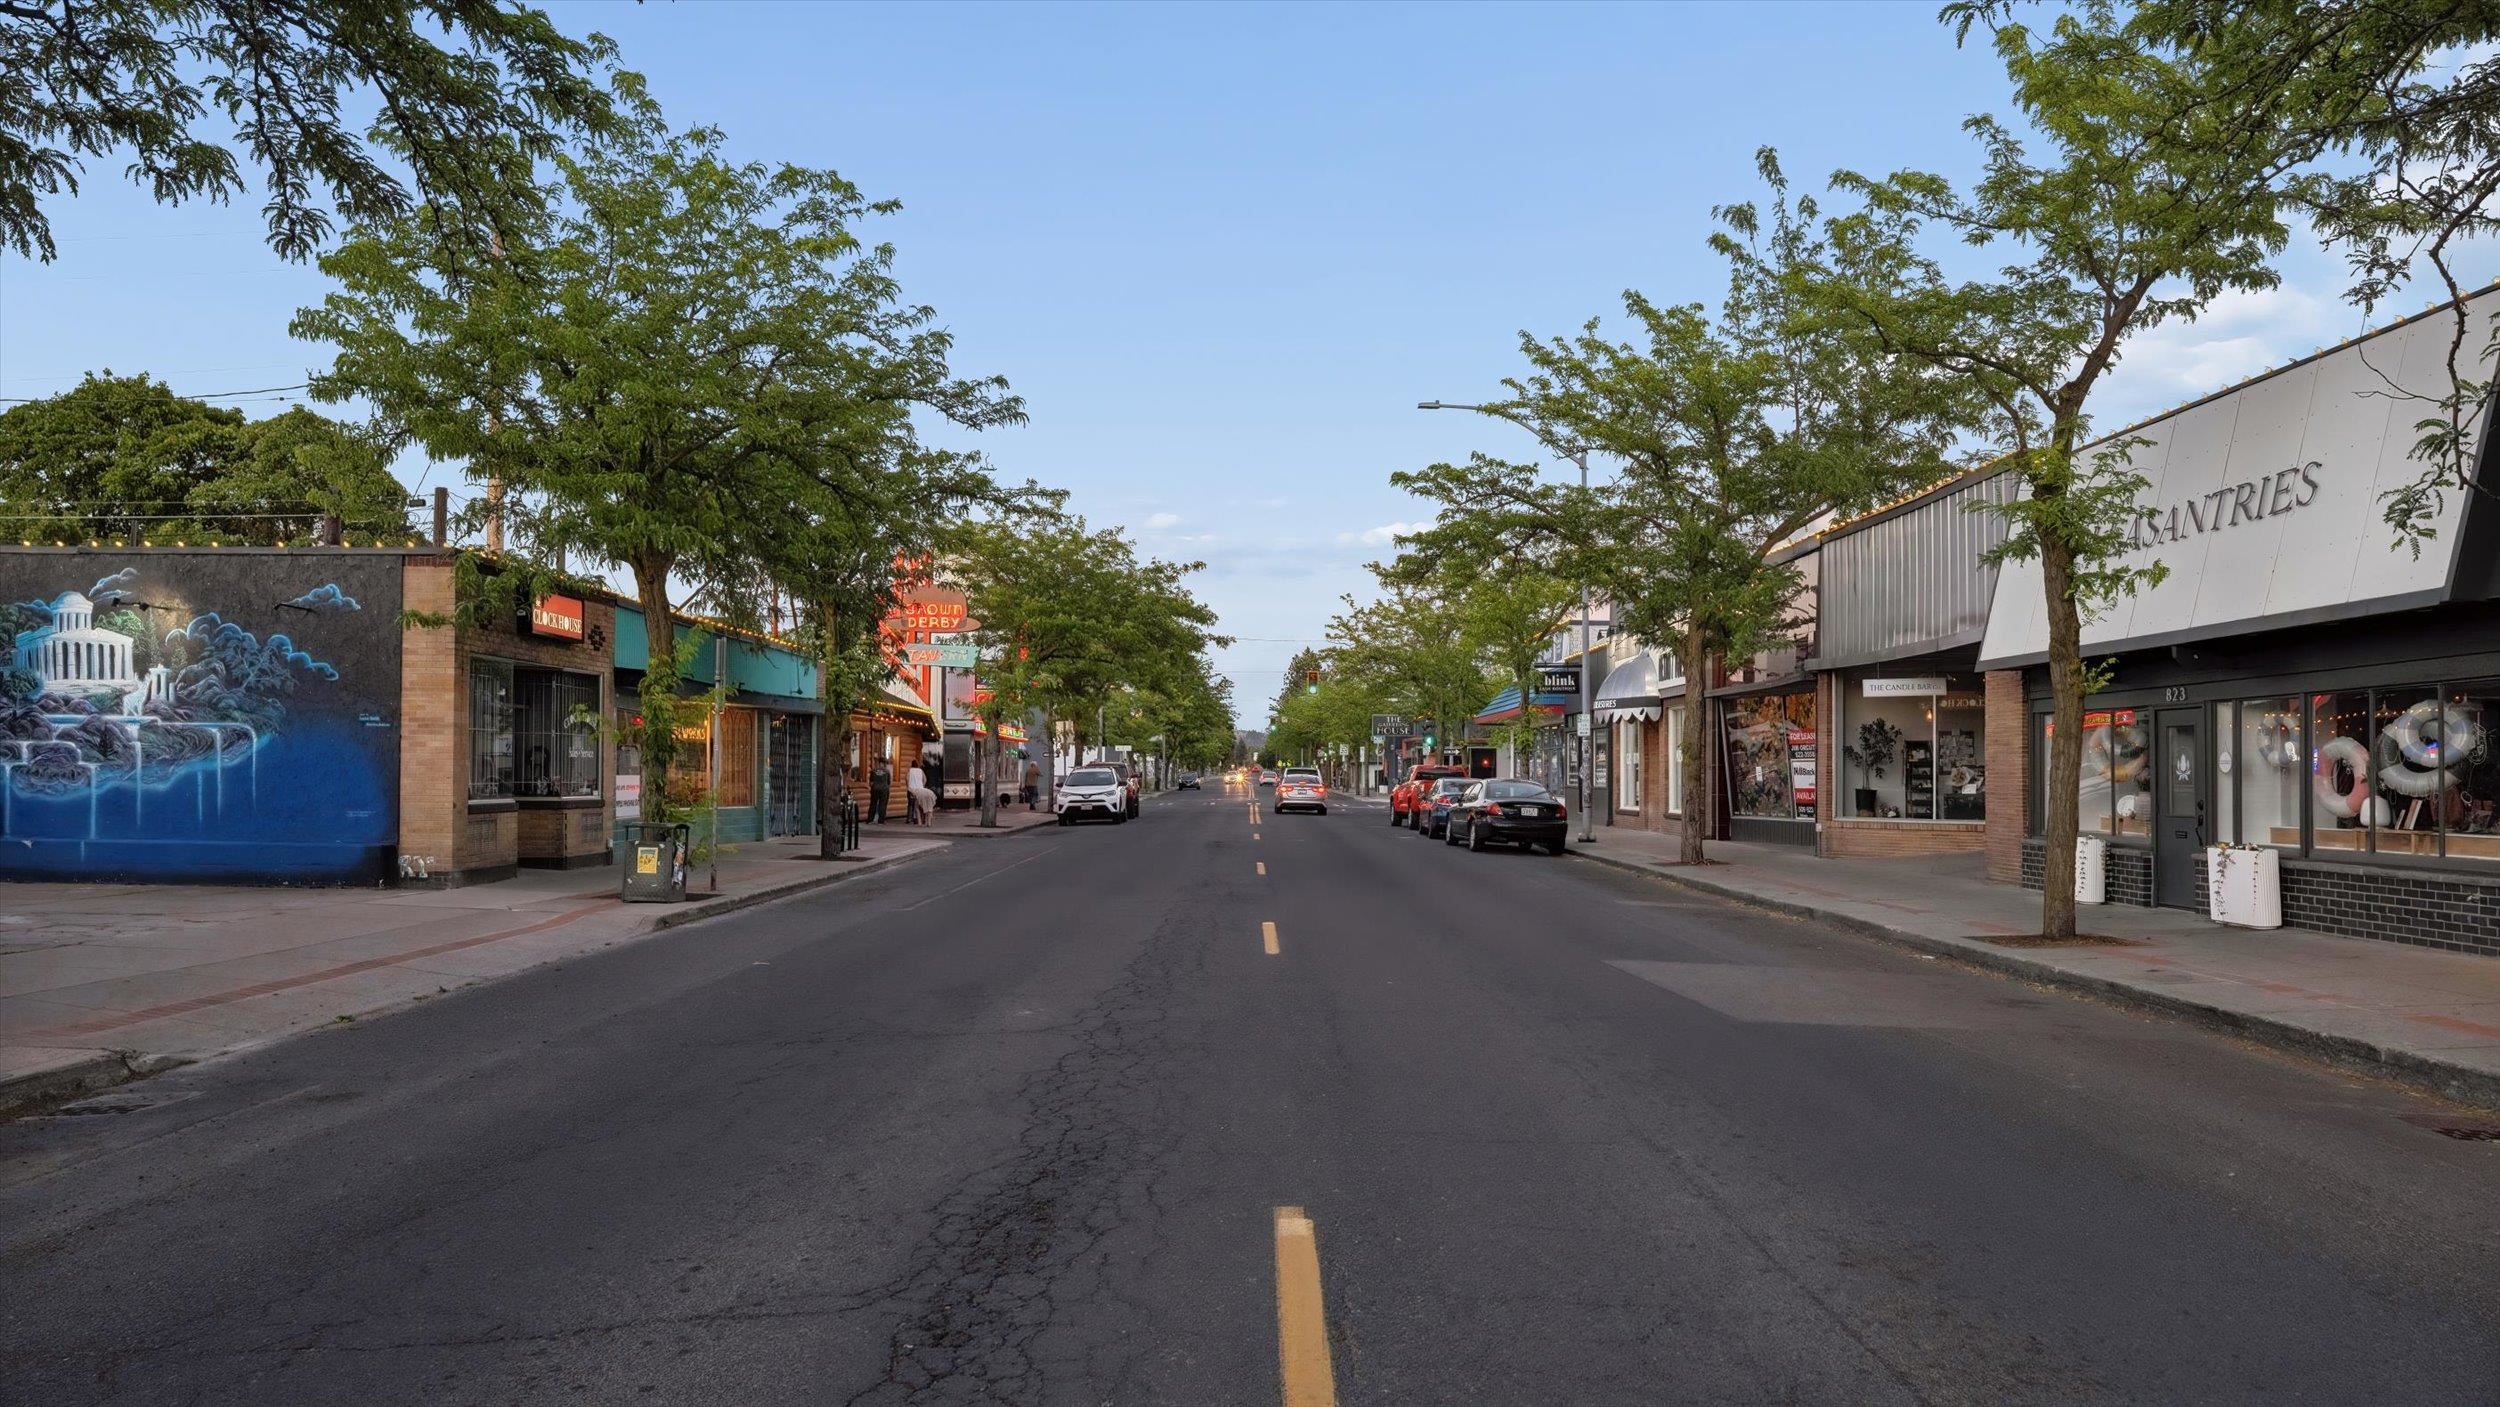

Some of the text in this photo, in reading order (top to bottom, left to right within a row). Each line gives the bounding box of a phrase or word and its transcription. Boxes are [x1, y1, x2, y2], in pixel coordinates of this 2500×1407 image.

[2110, 460, 2323, 552] ASANTRIES
[533, 609, 582, 634] CLOCK HOUSE
[908, 617, 960, 628] DERBY
[1544, 674, 1576, 686] blink
[1870, 684, 1883, 692] THE
[2165, 687, 2186, 701] 823
[1594, 699, 1617, 709] EASURES
[1376, 727, 1411, 735] HOUSE
[1796, 792, 1815, 800] AVAILA
